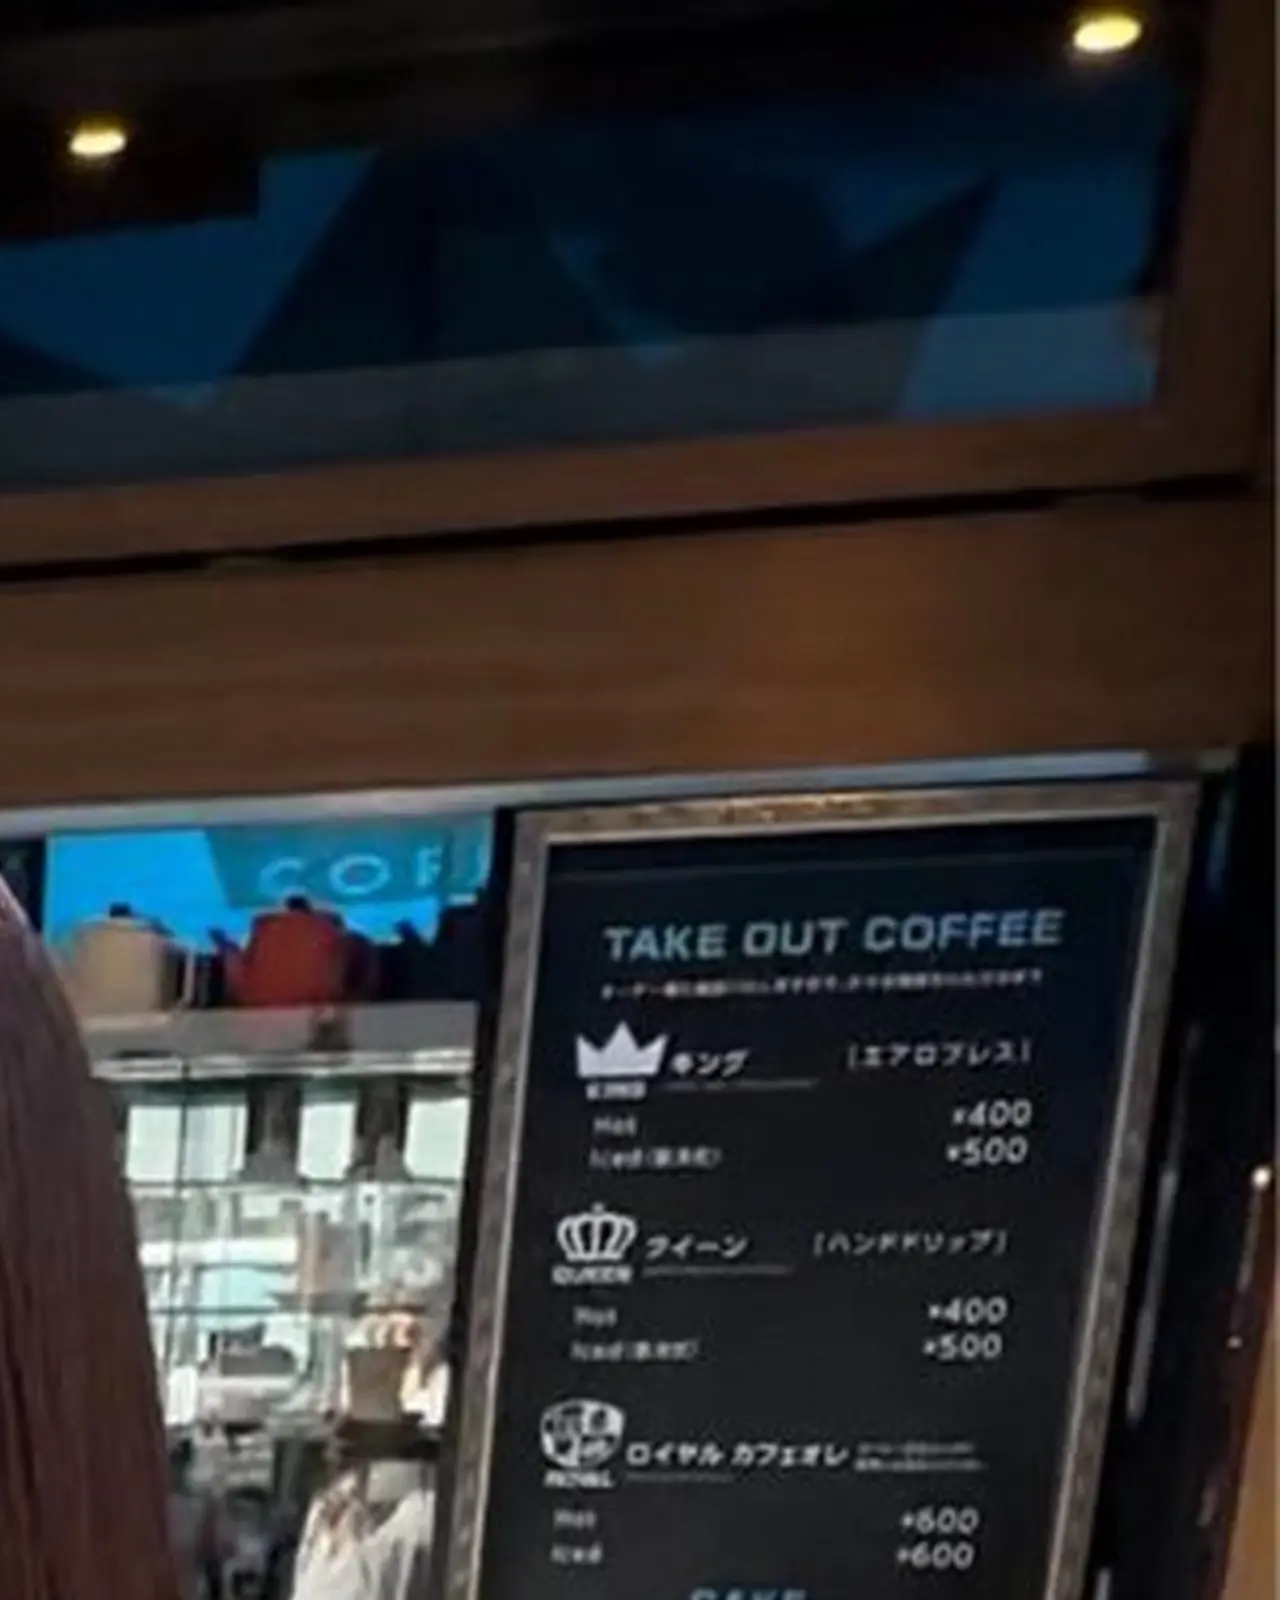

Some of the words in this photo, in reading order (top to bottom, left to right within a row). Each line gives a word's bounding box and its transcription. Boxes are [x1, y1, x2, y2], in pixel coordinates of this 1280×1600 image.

[601, 922, 729, 962] TAKE
[741, 915, 849, 959] OUT
[863, 907, 1066, 953] COFFEE
[670, 1049, 750, 1079] キング
[644, 1233, 749, 1261] クイーン
[625, 1440, 726, 1468] ロイヤル
